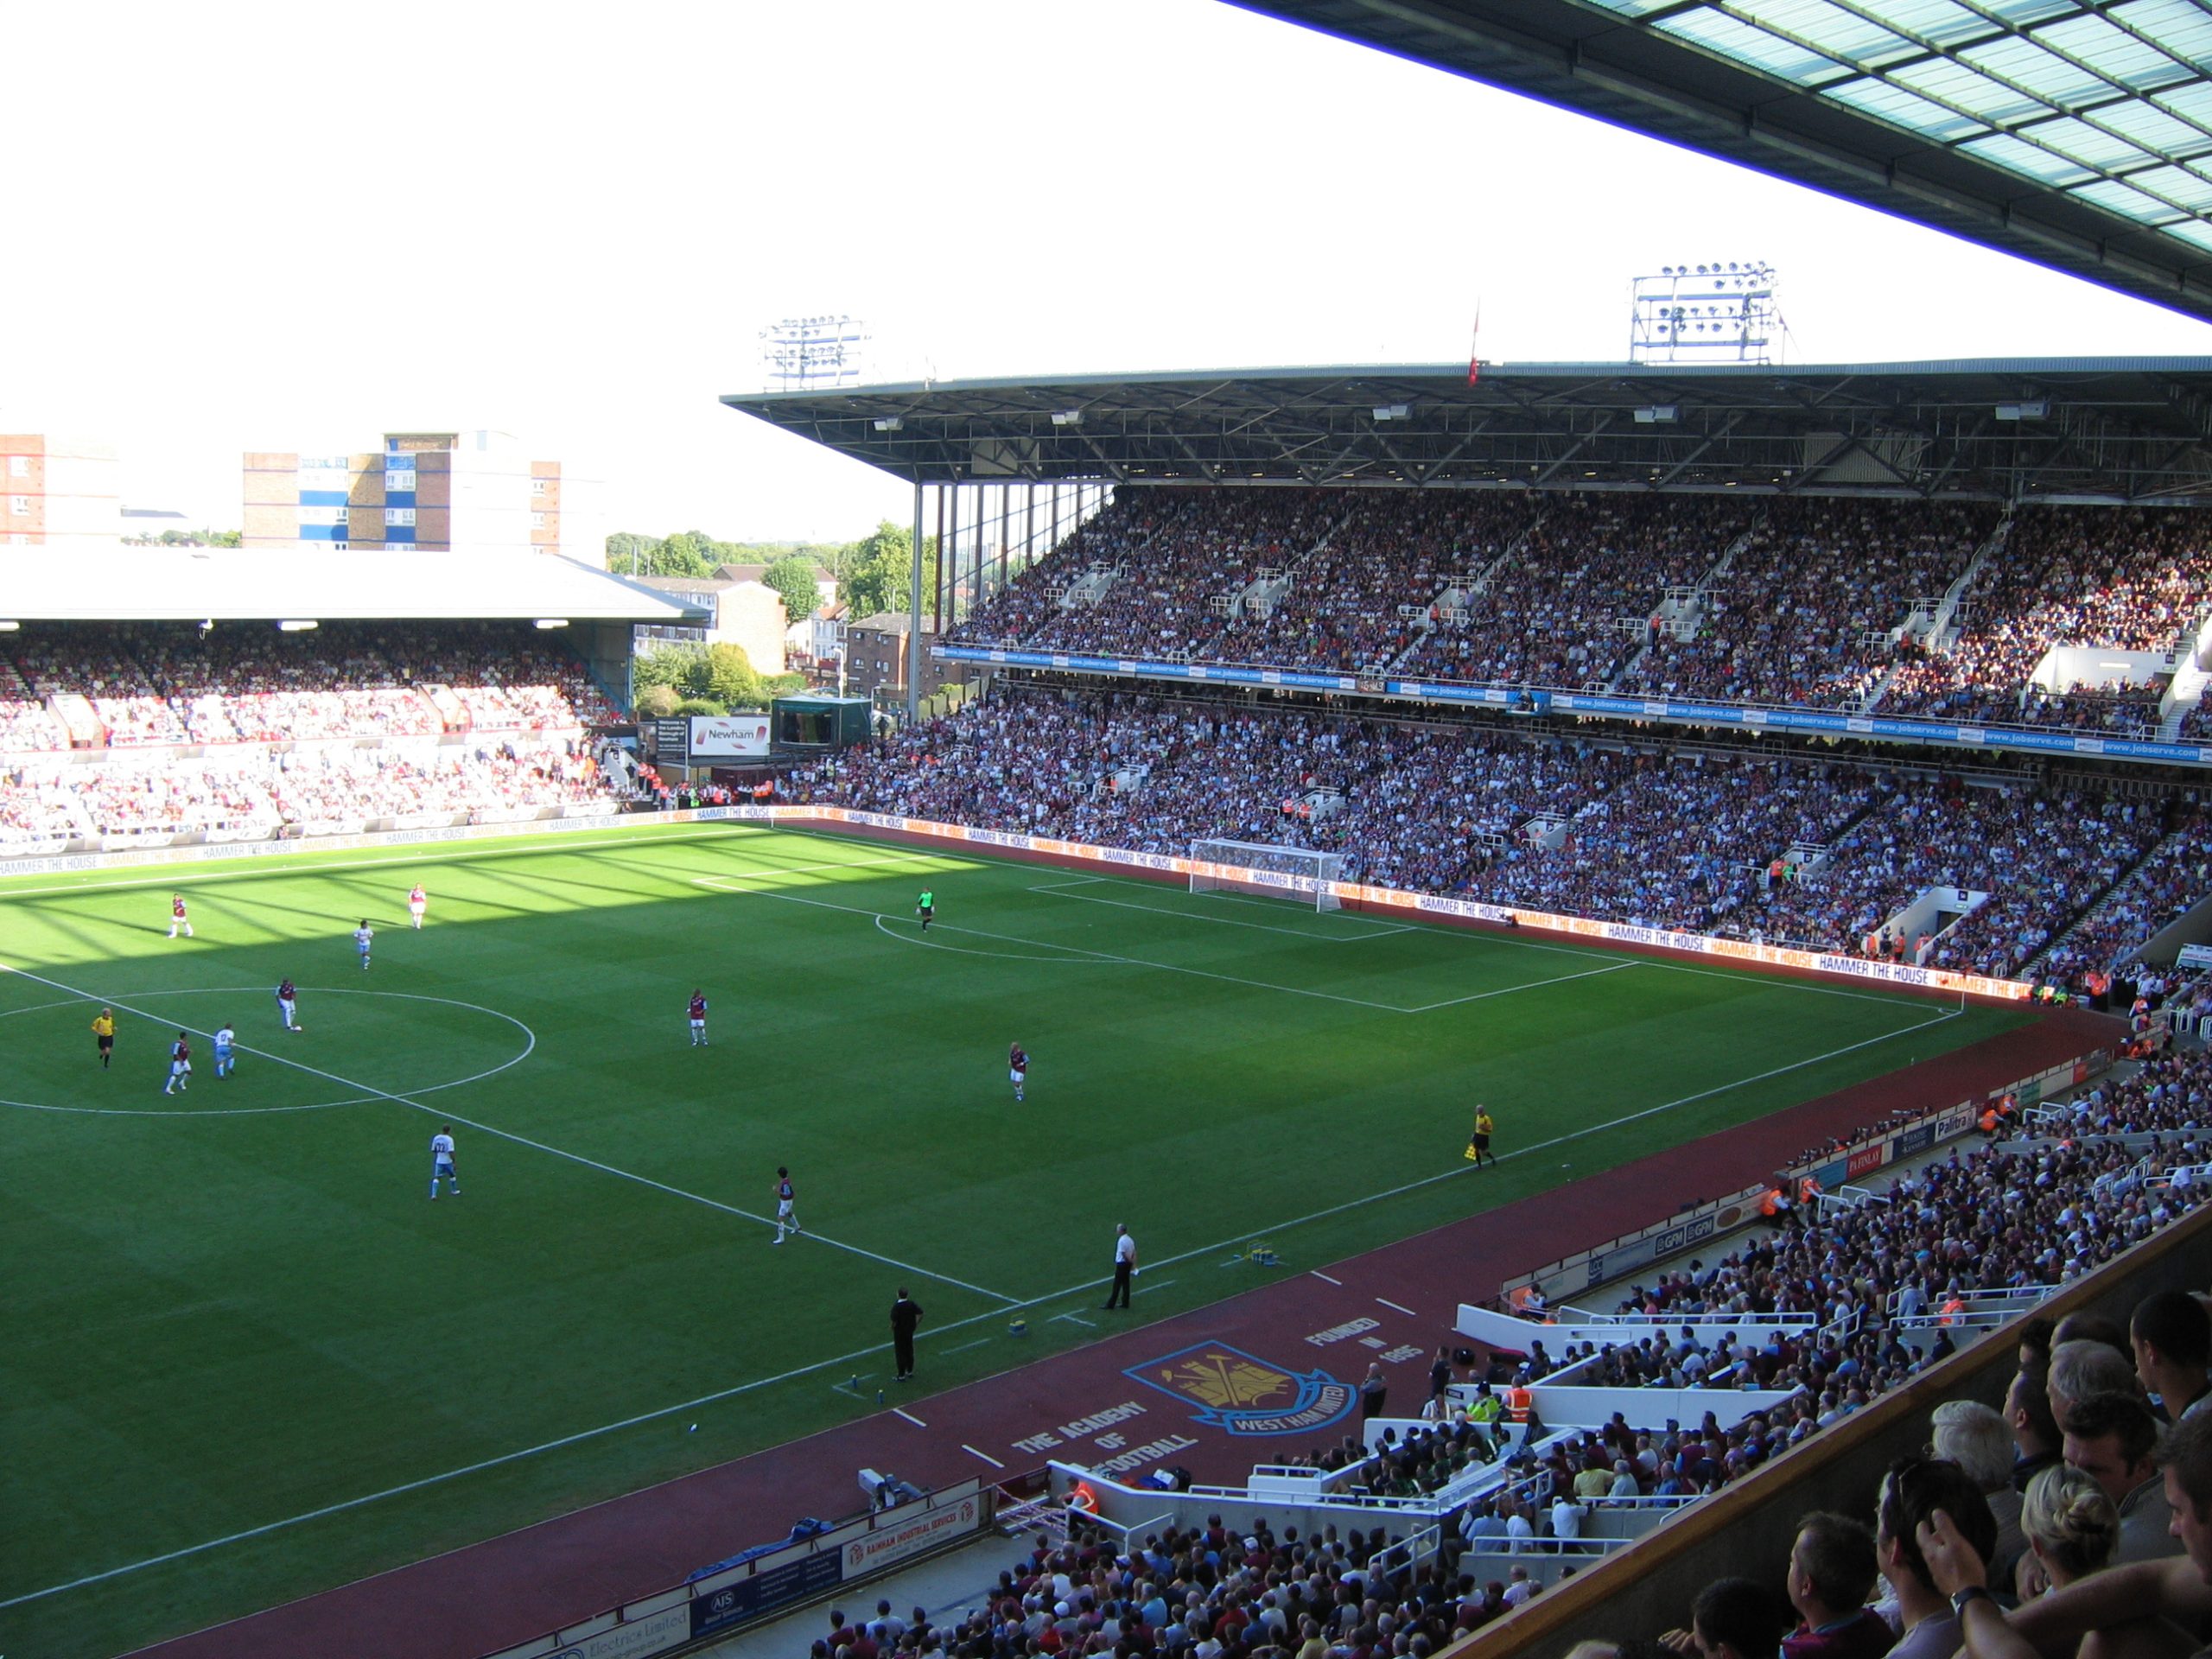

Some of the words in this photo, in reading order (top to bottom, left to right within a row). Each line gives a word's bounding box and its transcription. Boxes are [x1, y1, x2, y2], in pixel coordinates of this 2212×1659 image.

[1573, 698, 1643, 709] www.jobserve.com
[1668, 706, 1742, 719] www.jobserve.com
[1768, 714, 1847, 728] www.jobserve.com
[1873, 722, 1956, 735] www.jobserve.com
[709, 729, 754, 739] Newham
[1986, 733, 2074, 747] www.jobserve.com
[2104, 742, 2198, 757] www.jobserve.com
[697, 808, 727, 819] HAMMER
[729, 807, 742, 817] THE
[745, 807, 769, 817] HOUSE
[775, 807, 811, 817] HAMMER
[816, 807, 825, 817] THE
[828, 808, 844, 819] HOUSE
[848, 810, 873, 823] HAMMER
[875, 815, 884, 825] THE
[886, 817, 903, 829] HOUSE
[550, 818, 583, 830] HAMMER
[586, 817, 596, 829] THE
[599, 815, 620, 827] HOUSE
[908, 821, 932, 832] HAMMER
[936, 824, 944, 835] THE
[947, 826, 964, 837] HOUSE
[387, 830, 423, 843] HAMMER
[426, 830, 437, 841] THE
[442, 828, 465, 840] HOUSE
[969, 829, 995, 842] HAMMER
[999, 833, 1007, 844] THE
[1010, 835, 1030, 848] HOUSE
[203, 845, 244, 859] HAMMER
[247, 843, 261, 856] THE
[264, 842, 291, 855] HOUSE
[1034, 838, 1063, 852] HAMMER
[1065, 842, 1075, 854] THE
[1078, 843, 1098, 857] HOUSE
[48, 859, 63, 872] THE
[67, 857, 98, 870] HOUSE
[1103, 850, 1134, 864] HAMMER
[1136, 855, 1147, 866] THE
[1150, 856, 1171, 869] HOUSE
[1210, 864, 1223, 876] THE
[1226, 868, 1249, 880] HOUSE
[1253, 870, 1288, 886] HAMMER
[1292, 876, 1302, 889] THE
[1306, 879, 1330, 893] HOUSE
[1335, 883, 1371, 901] HAMMER
[1374, 888, 1388, 902] THE
[1390, 891, 1415, 907] HOUSE
[1421, 897, 1459, 914] HAMMER
[1462, 902, 1476, 915] THE
[1478, 905, 1506, 920] HOUSE
[1555, 917, 1570, 930] THE
[1573, 918, 1603, 935] HOUSE
[1608, 924, 1651, 944] HAMMER
[1655, 931, 1670, 945] THE
[1674, 932, 1704, 950] HOUSE
[1711, 940, 1757, 958] HAMMER
[1761, 946, 1777, 962] THE
[1781, 950, 1812, 967] HOUSE
[1820, 957, 1868, 976] HAMMER
[1872, 963, 1890, 979] THE
[1894, 966, 1928, 983] HOUSE
[1936, 973, 1987, 993] HAMMER
[1992, 981, 2010, 996] THE
[1937, 1116, 1967, 1136] Palitra
[1304, 1318, 1381, 1346] FOUNDED
[1358, 1337, 1388, 1349] IN
[1379, 1344, 1424, 1363] 1895
[1236, 1418, 1287, 1431] WEST
[1285, 1410, 1327, 1427] HAM
[1313, 1386, 1344, 1414] UNITED
[1011, 1432, 1064, 1453] THE
[1058, 1401, 1147, 1439] ACADEMY
[1094, 1432, 1127, 1449] OF
[867, 1535, 896, 1555] RAINHAM
[896, 1522, 930, 1543] INDUSTRIAL
[931, 1512, 957, 1529] SERVICES
[589, 1630, 643, 1658] Electrics
[645, 1610, 686, 1638] Limited
